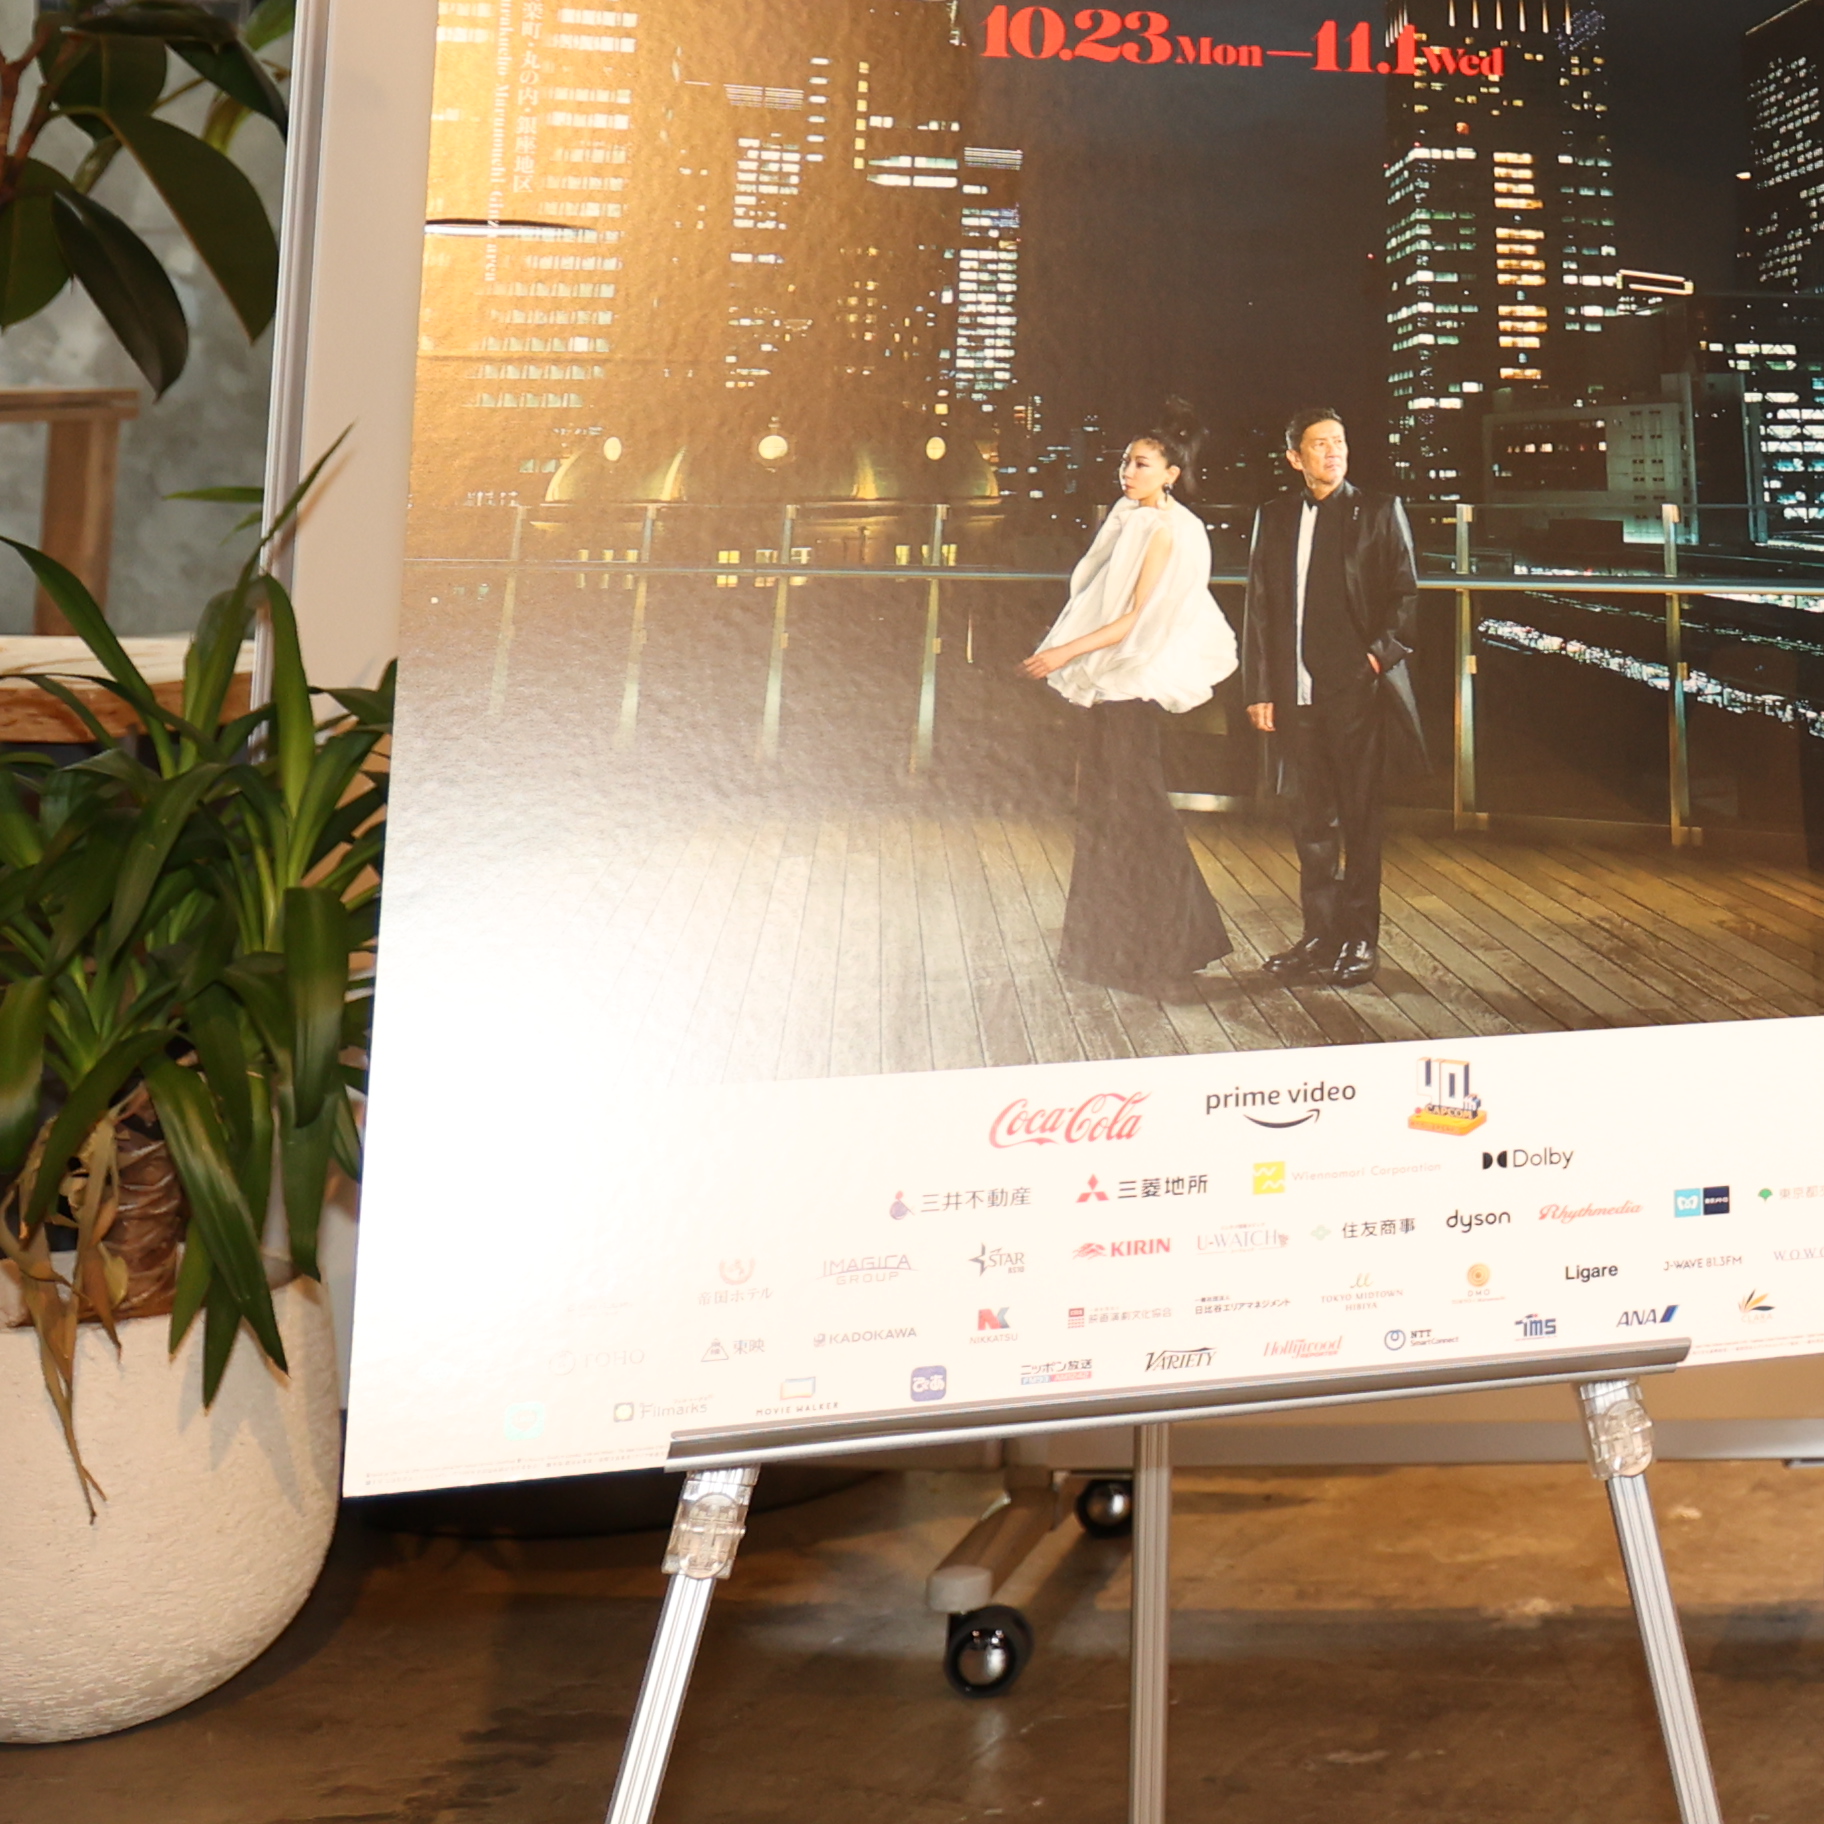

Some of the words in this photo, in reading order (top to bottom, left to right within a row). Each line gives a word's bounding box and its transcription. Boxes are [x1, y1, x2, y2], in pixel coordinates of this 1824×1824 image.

[978, 5, 1171, 65] 10.23
[1205, 1086, 1281, 1115] prime
[1287, 1081, 1357, 1105] video
[1425, 1103, 1476, 1120] CAPCOM
[1512, 1147, 1574, 1170] Dolby
[1116, 1174, 1208, 1200] 三菱地所
[920, 1186, 1032, 1213] 三井不動産
[1446, 1209, 1511, 1233] dyson
[1538, 1200, 1643, 1224] Rhythmedia
[1342, 1218, 1416, 1239] 住友商事
[1110, 1238, 1171, 1257] KIRIN
[823, 1255, 911, 1275] IMAGICA
[989, 1251, 1025, 1268] STAR
[1664, 1258, 1704, 1271] J-WAVE
[1706, 1255, 1742, 1268] 81.3FM
[836, 1271, 899, 1285] GROUP
[1565, 1264, 1618, 1282] Ligare
[698, 1288, 773, 1306] 帝国ホテル
[1321, 1293, 1353, 1304] TOKYO
[1356, 1290, 1404, 1300] MIDTOWN
[1195, 1299, 1291, 1315] 日比谷エリアマネジメント
[1616, 1308, 1658, 1327] ANA
[829, 1328, 917, 1344] KADOKAWA
[969, 1333, 1018, 1344] NIKKATSU
[1410, 1329, 1432, 1338] NTT
[733, 1338, 765, 1355] 東映
[1263, 1335, 1343, 1358] Hollywood
[1020, 1359, 1093, 1376] ニッポン放送
[1144, 1347, 1217, 1372] VARIETY
[912, 1374, 945, 1392] ぴあ
[639, 1402, 708, 1420] Filmarks
[756, 1407, 791, 1417] MOVIE
[796, 1402, 838, 1413] WALKER
